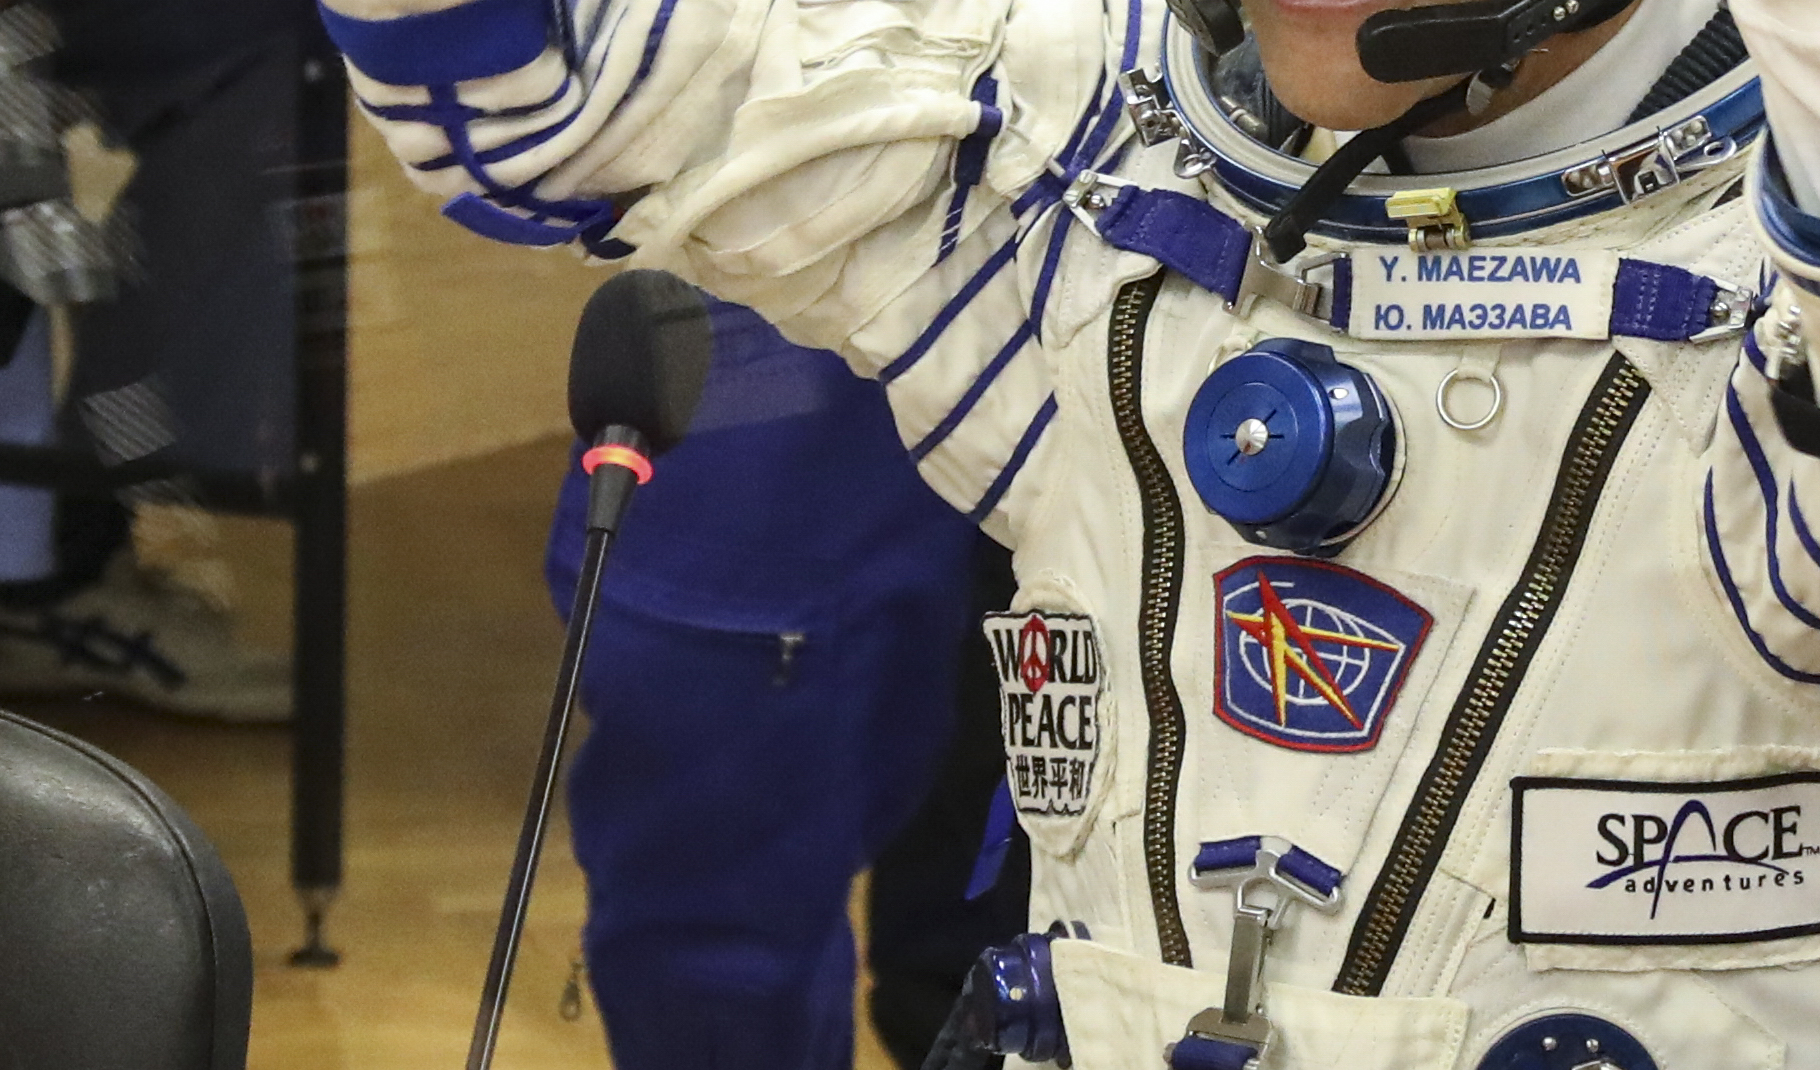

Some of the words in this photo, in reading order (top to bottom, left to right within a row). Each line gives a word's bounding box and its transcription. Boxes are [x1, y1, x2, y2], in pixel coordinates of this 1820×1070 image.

[1379, 255, 1407, 282] Y.
[1417, 255, 1582, 283] MAEZAWA
[1374, 303, 1412, 330] Ю.
[1422, 303, 1572, 330] МАЭЗАВА
[992, 615, 1097, 692] WORLD
[1007, 693, 1094, 750] PEACE
[1014, 753, 1086, 801] 世界平和
[1595, 799, 1804, 871] SPACE
[1624, 870, 1806, 894] adventures
